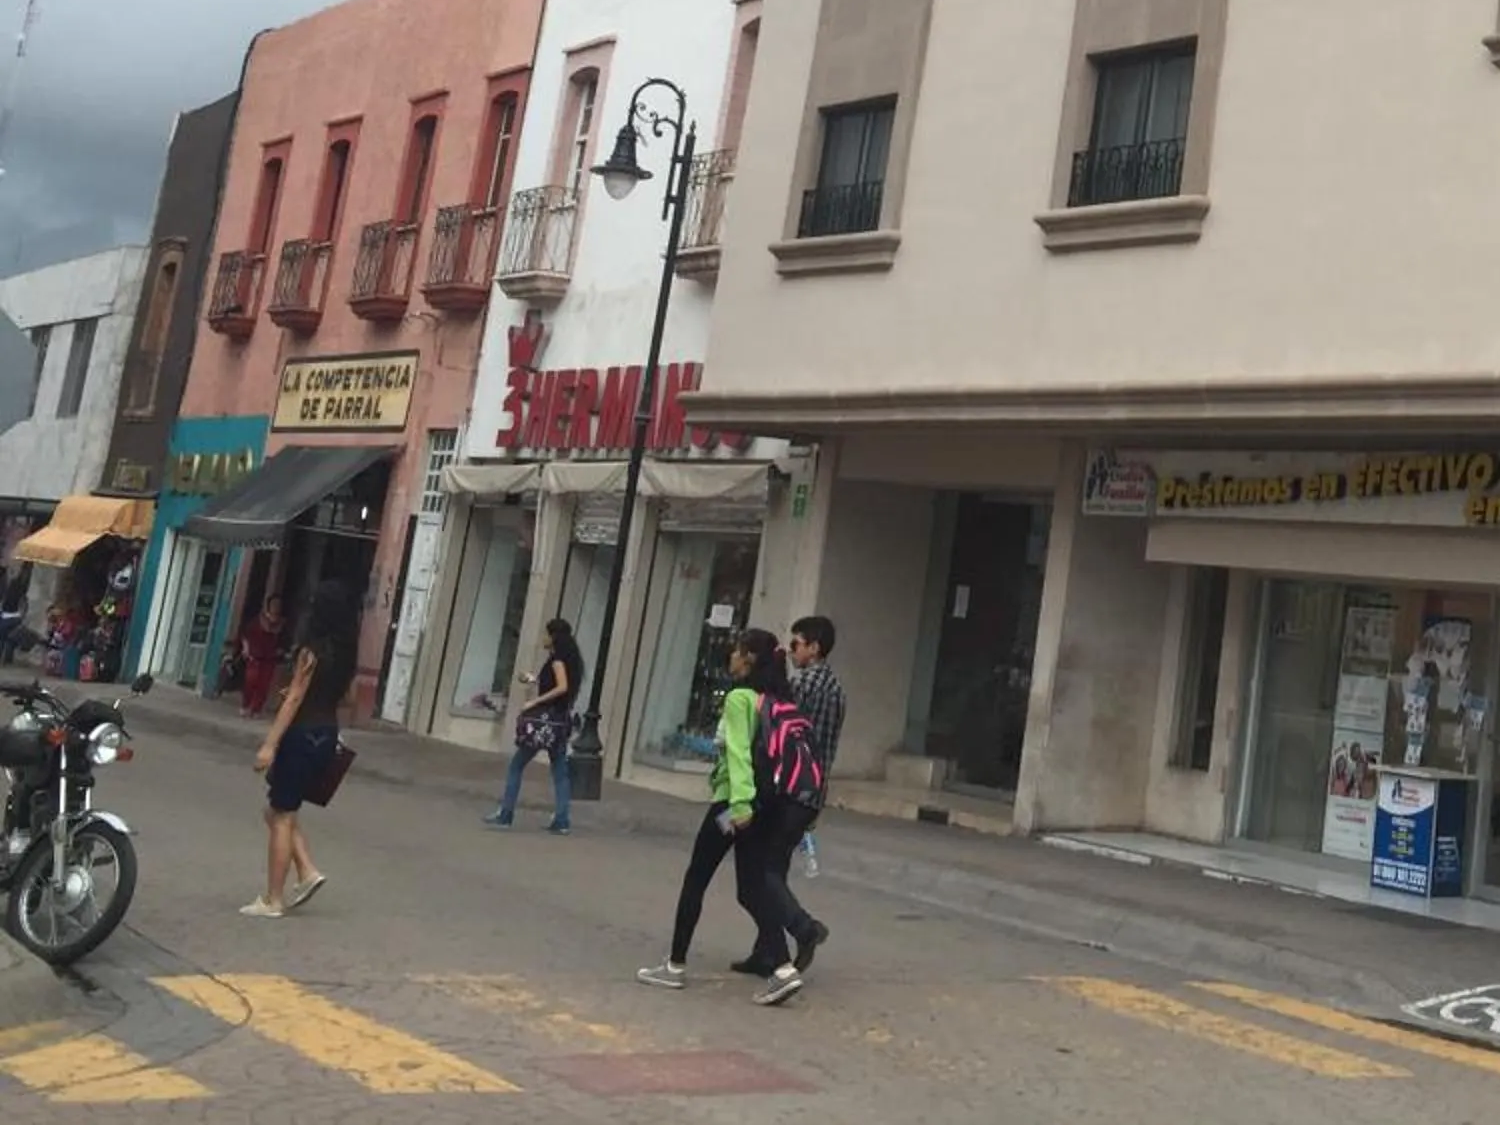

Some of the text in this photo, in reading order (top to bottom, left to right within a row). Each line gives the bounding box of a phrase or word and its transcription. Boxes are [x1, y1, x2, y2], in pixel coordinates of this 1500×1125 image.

[283, 364, 411, 393] LA COMPETENCIA
[300, 396, 383, 421] DE PARRAL
[496, 361, 746, 452] 3HERMN
[1304, 474, 1342, 501] en
[1350, 452, 1497, 498] EFECTIVO
